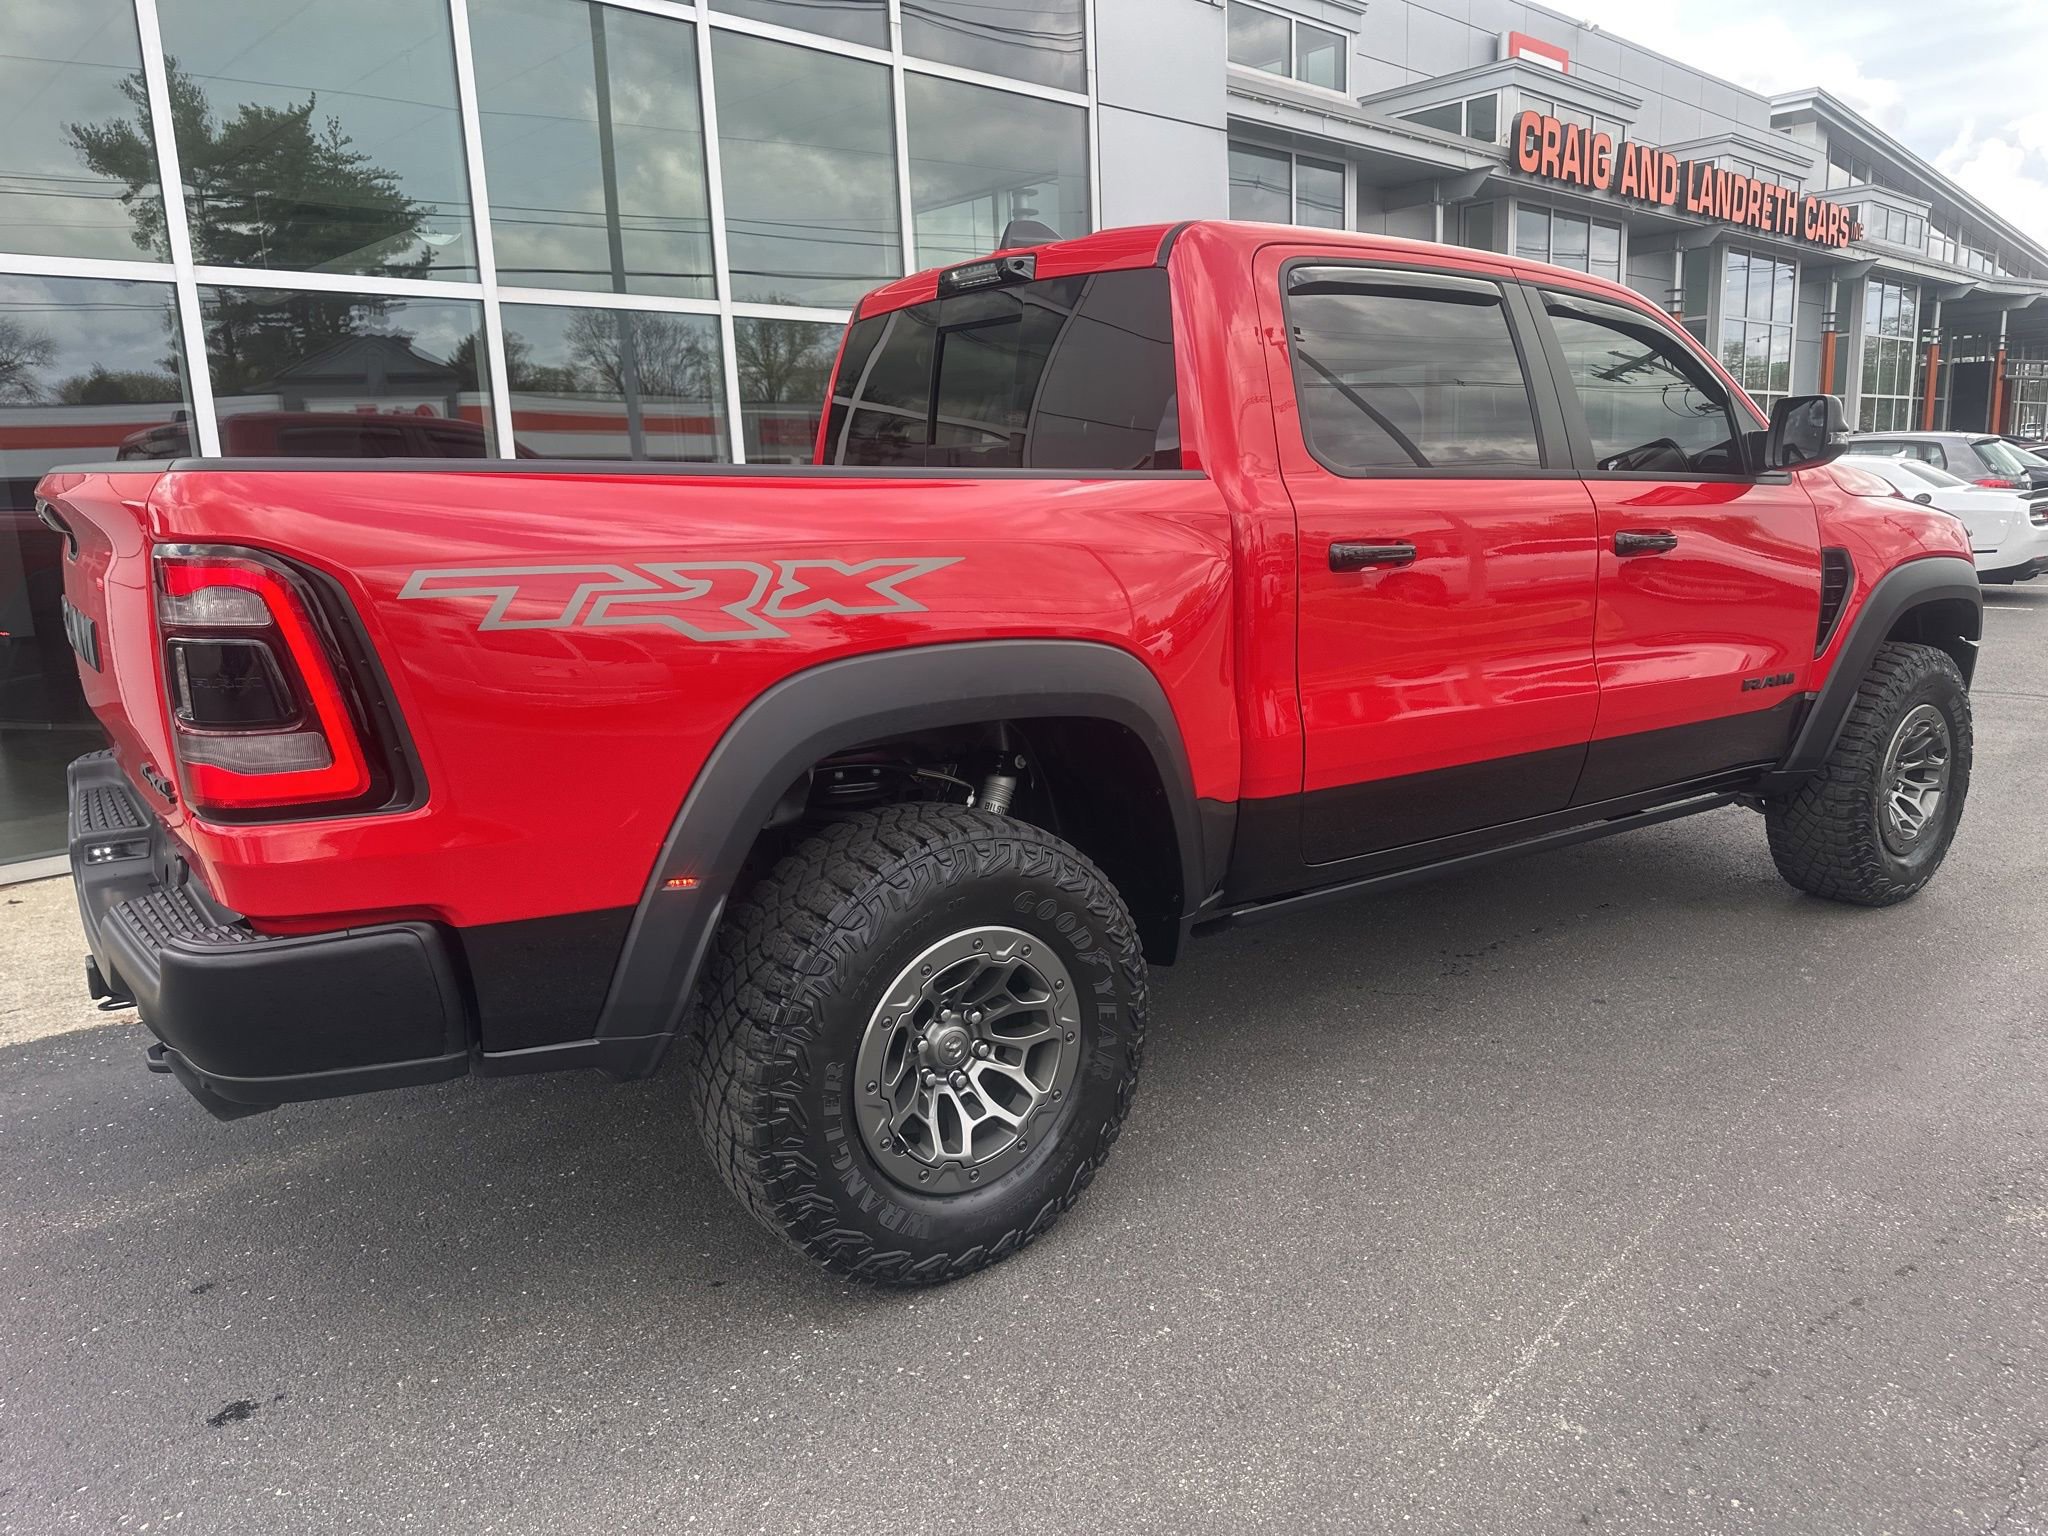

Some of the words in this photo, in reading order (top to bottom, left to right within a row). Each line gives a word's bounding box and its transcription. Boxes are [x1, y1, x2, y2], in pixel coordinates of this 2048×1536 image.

[1517, 110, 1612, 190] CRAIG
[1620, 141, 1678, 206] AND
[1686, 160, 1800, 237] LANDRETH
[1804, 195, 1850, 248] CARS
[396, 556, 967, 642] TRX
[1741, 672, 1795, 692] RAM
[1012, 889, 1120, 1081] GOODYEAR
[821, 1061, 932, 1240] WRANGLER
